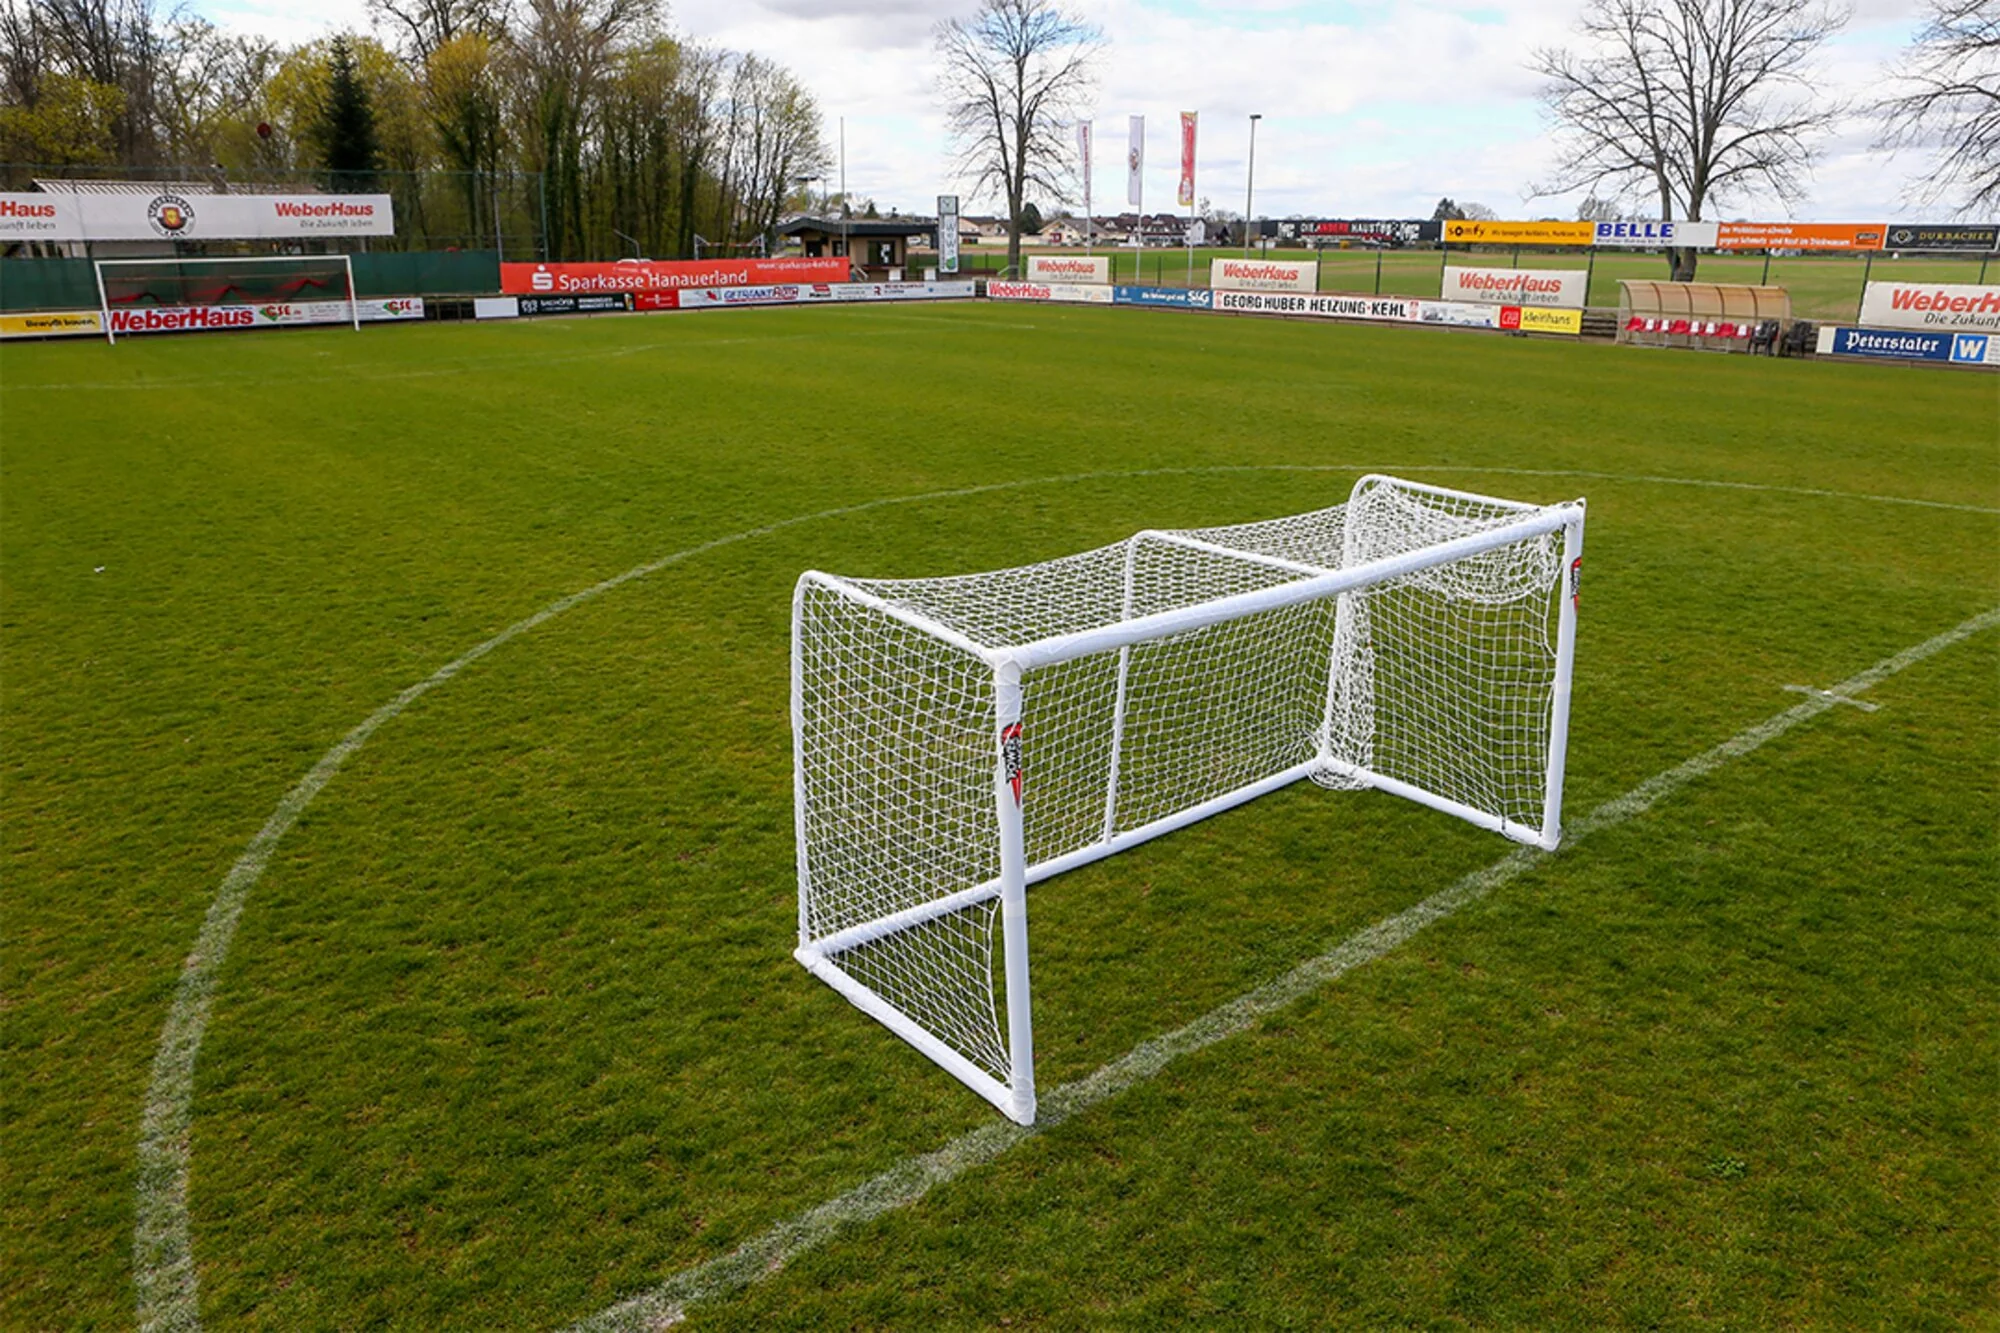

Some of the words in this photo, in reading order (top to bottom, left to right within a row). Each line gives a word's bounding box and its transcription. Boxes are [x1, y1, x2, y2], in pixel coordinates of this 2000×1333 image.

[0, 201, 56, 217] Haus
[275, 202, 374, 217] WeberHaus
[1448, 224, 1485, 238] somfy
[1597, 223, 1675, 238] BELLE
[1036, 260, 1095, 273] WeberHaus
[1223, 263, 1299, 281] WeberHaus
[558, 274, 644, 292] Sparkasse
[648, 269, 748, 288] Hanauerland
[1459, 272, 1562, 293] WeberHaus
[988, 281, 1051, 298] WeberHaus
[1223, 294, 1262, 309] GEORG
[1264, 296, 1306, 310] HUBER
[103, 307, 254, 331] WeberHaus
[1924, 312, 1947, 324] Die
[1846, 331, 1940, 352] Peterstaler
